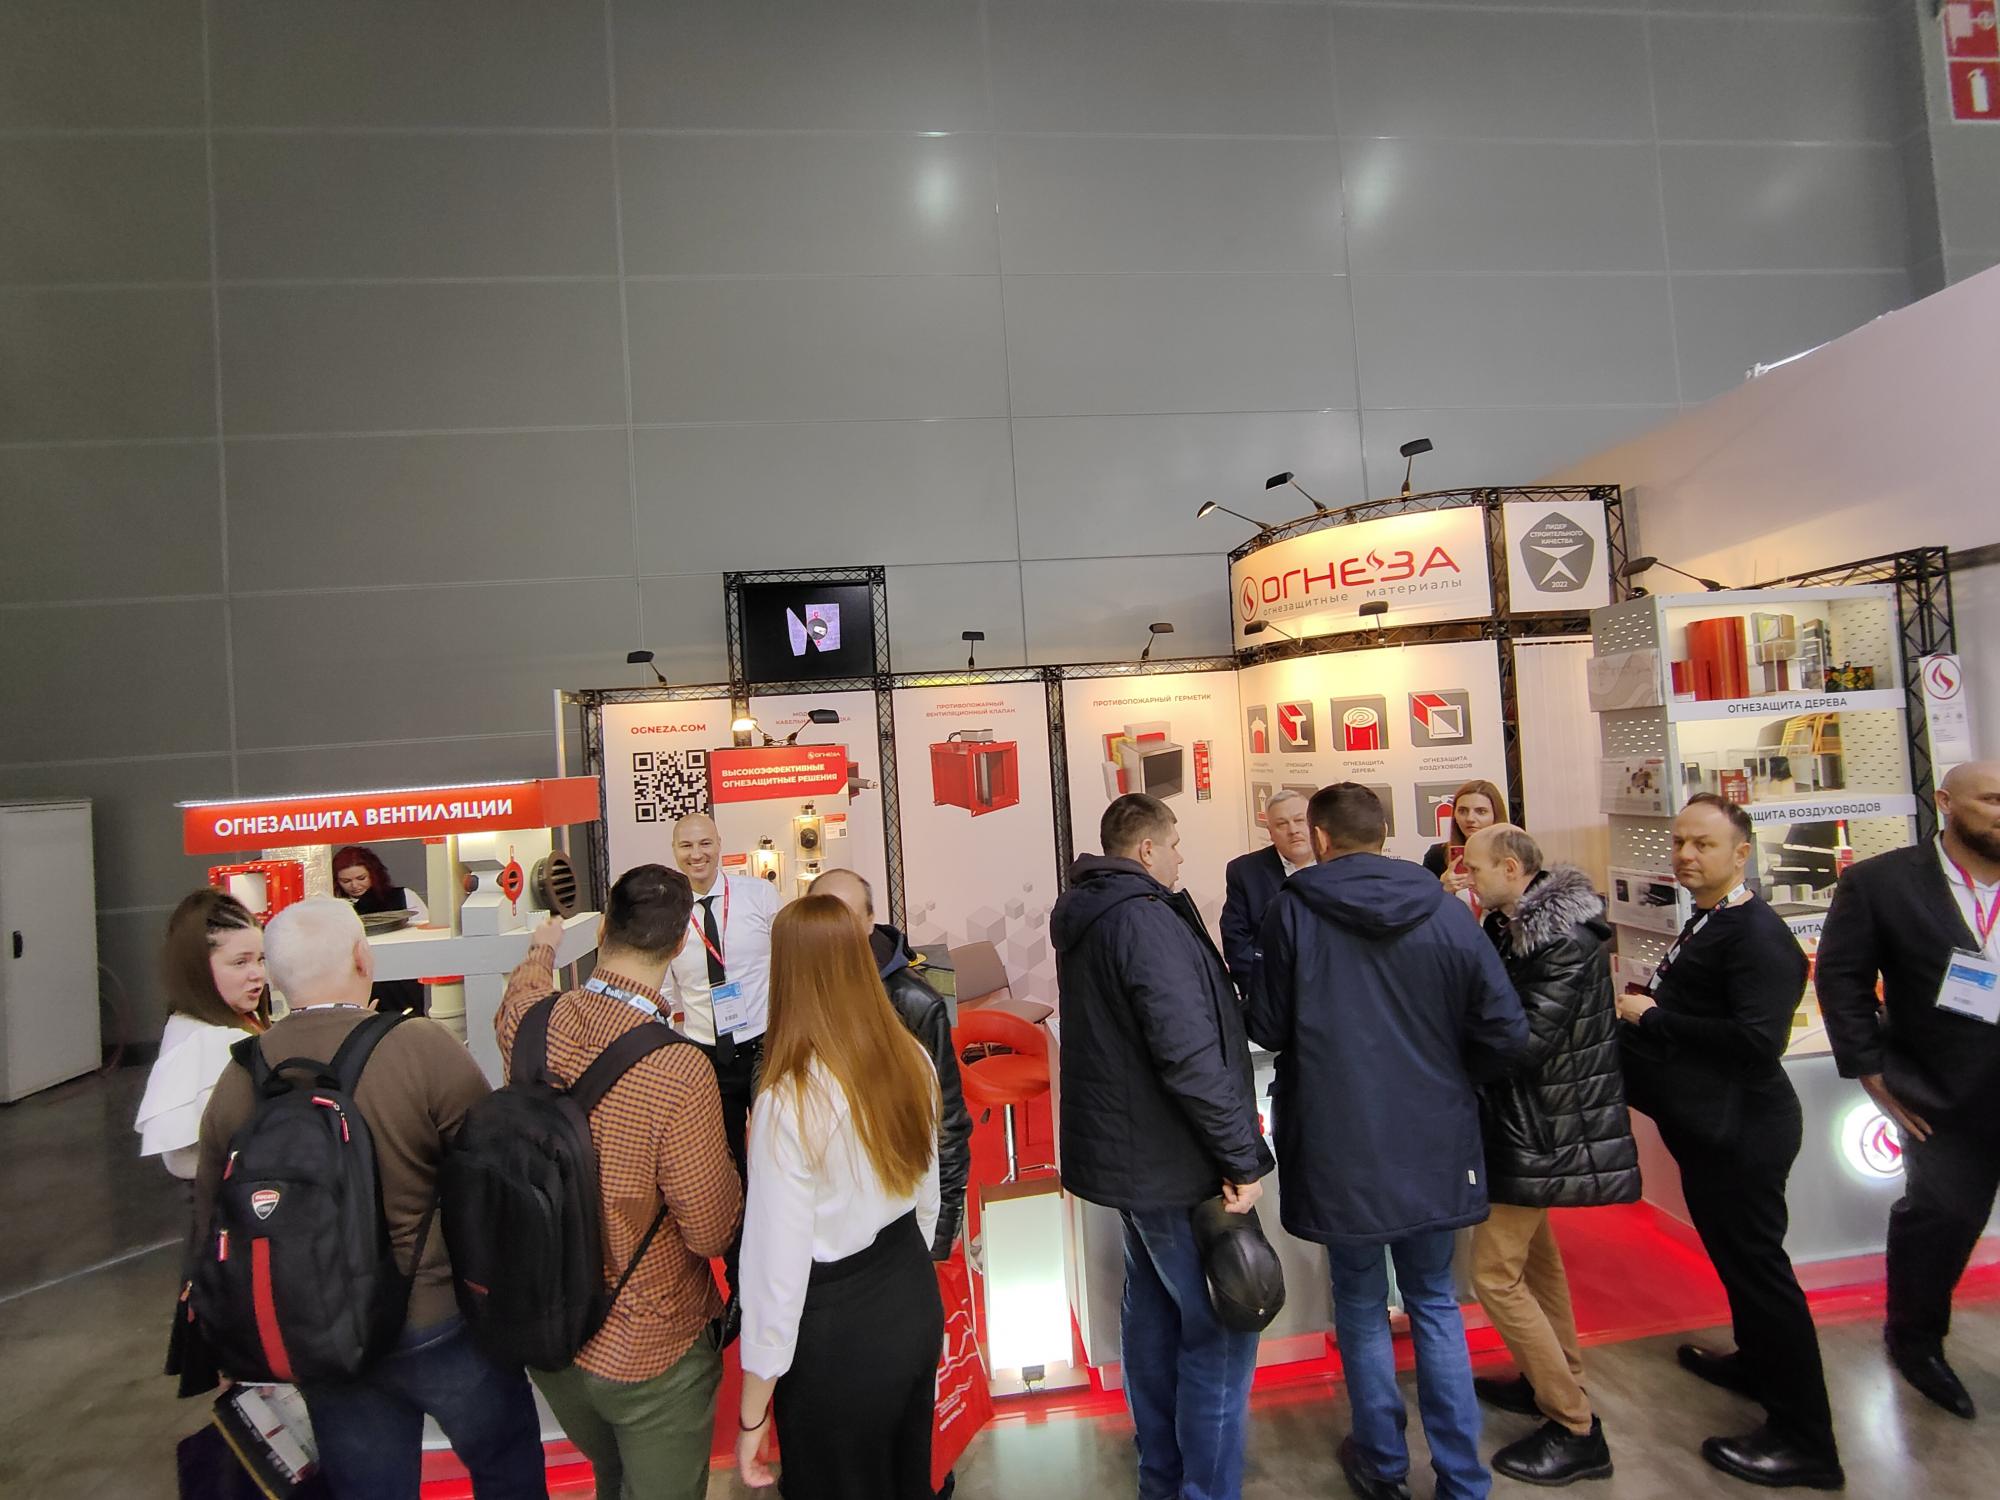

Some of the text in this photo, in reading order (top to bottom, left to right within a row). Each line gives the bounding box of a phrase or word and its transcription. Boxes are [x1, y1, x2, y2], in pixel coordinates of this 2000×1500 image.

[1263, 578, 1463, 617] огнезащитные материалы
[1092, 693, 1212, 707] ПРОТИВОПОЖАРНЫЙ ГЕРМЕТИК
[1727, 697, 1848, 714] ОГНЕЗАЩИТА ДЕРЕВА
[630, 723, 707, 735] OGNEZA.COM
[721, 763, 825, 777] ВЫСОКОЭФФЕКТИВНЫЕ
[722, 773, 838, 788] ОГНЕЗАЩИТНЫЕ РЕШЕНИЯ
[214, 798, 513, 837] ОГНЕЗАЩИТА ВЕНТИЛЯЦИИ
[1789, 802, 1881, 819] ВОЗДУХОВОДОВ
